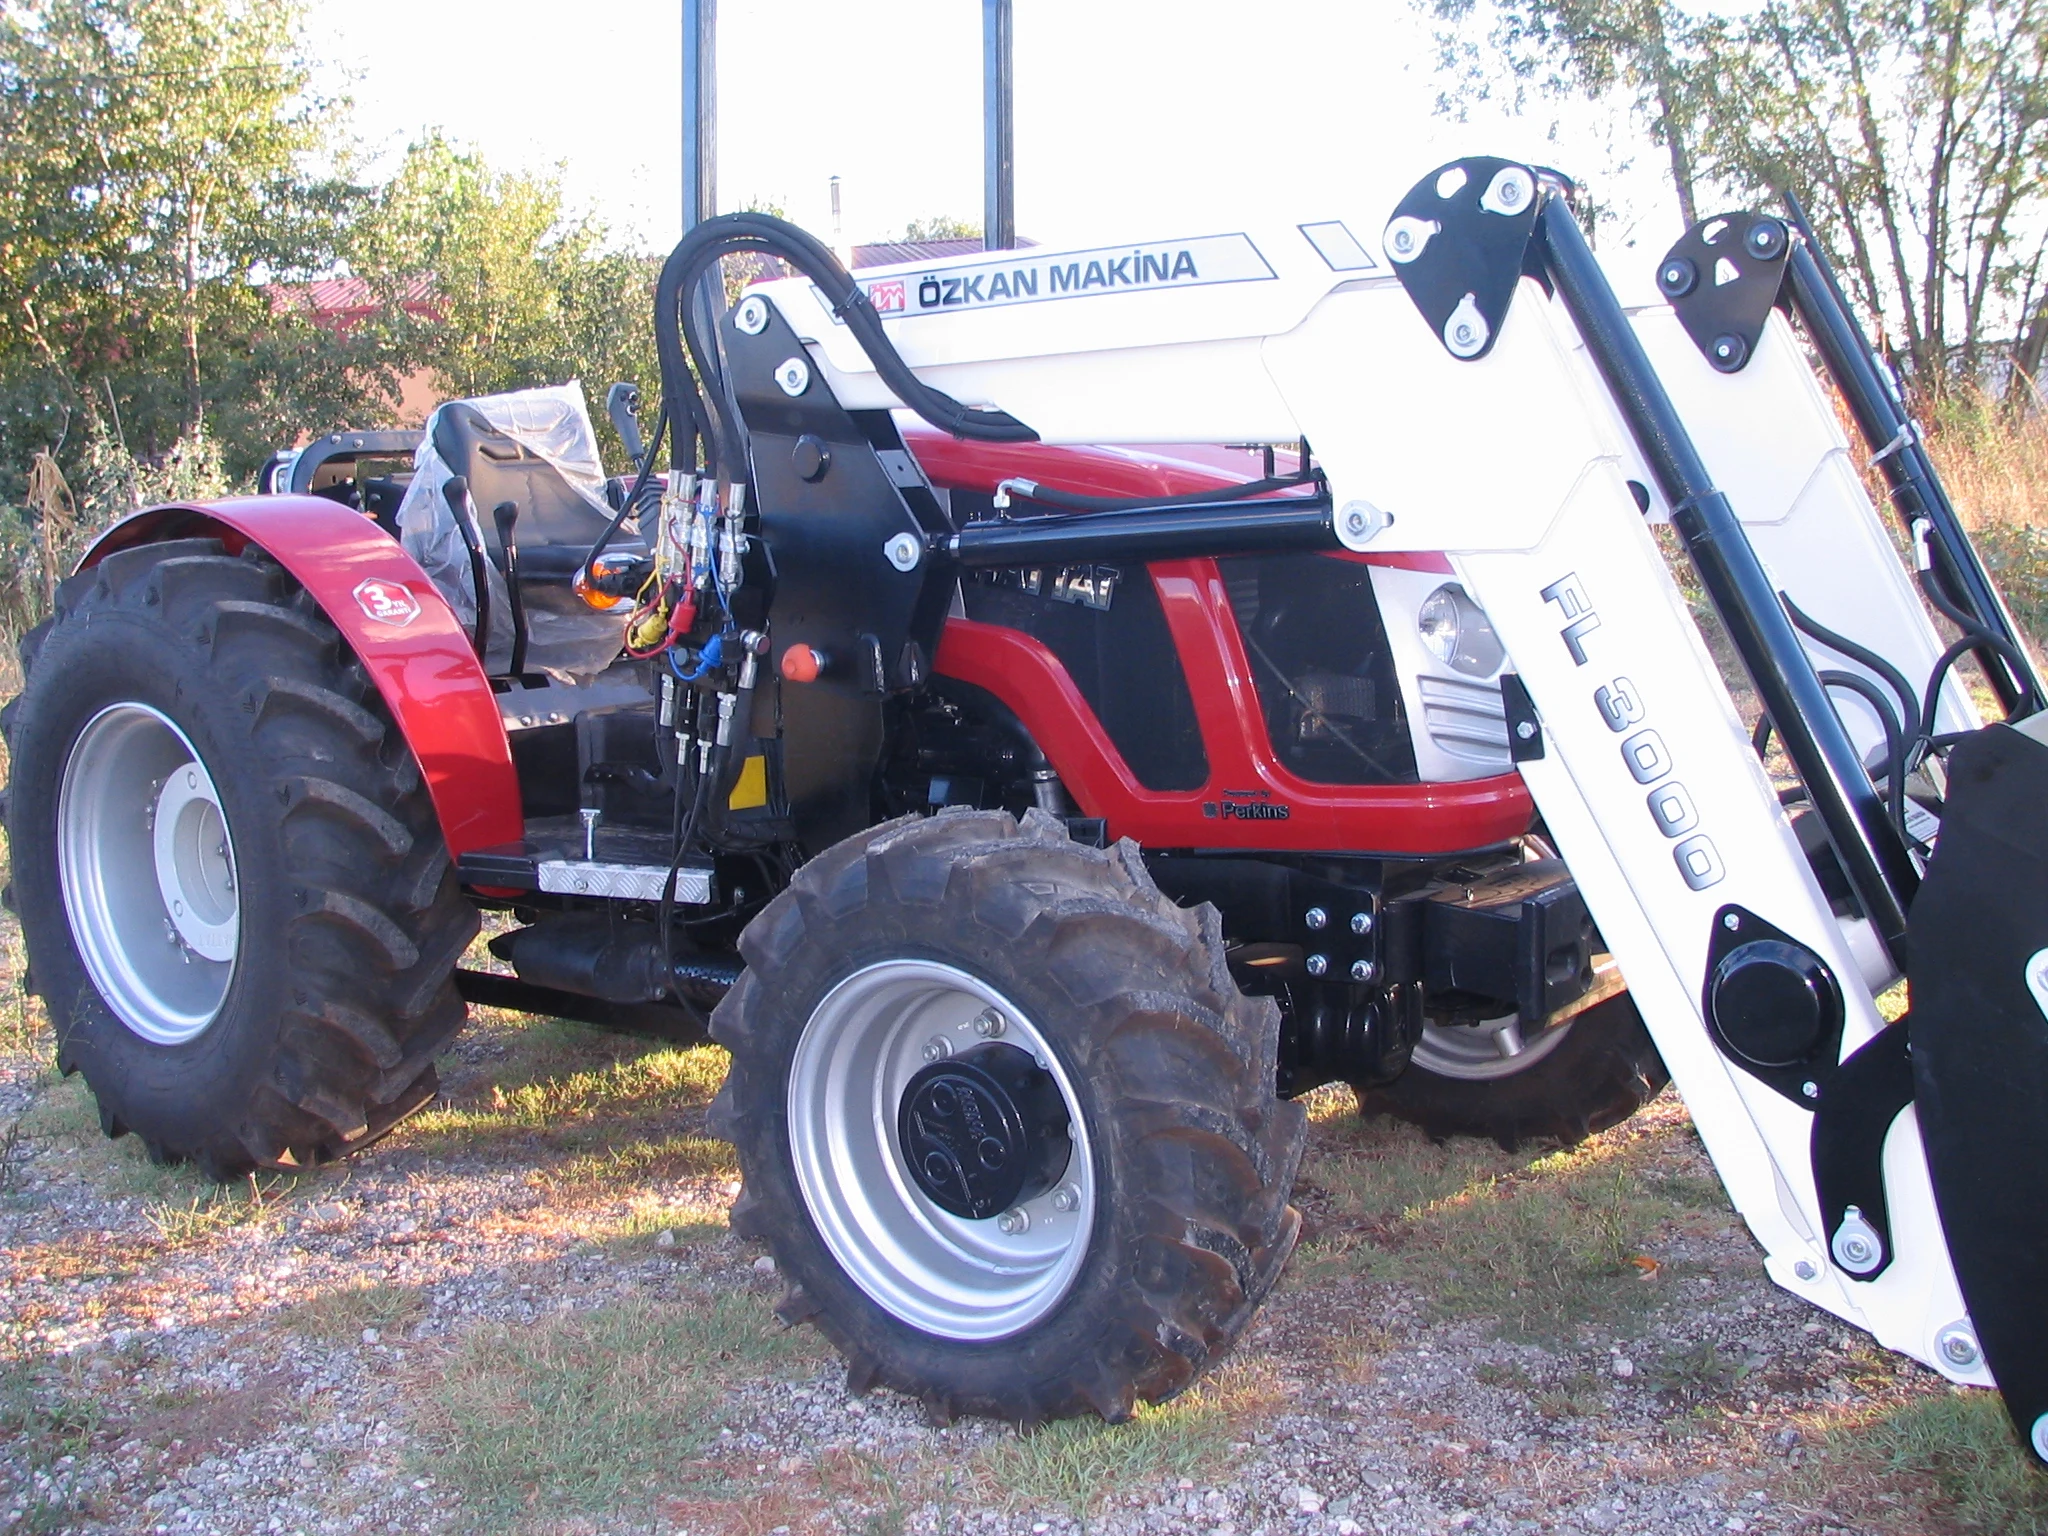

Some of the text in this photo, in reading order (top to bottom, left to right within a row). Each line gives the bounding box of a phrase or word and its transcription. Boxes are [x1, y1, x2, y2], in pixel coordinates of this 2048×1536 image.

[919, 267, 1038, 308] ÖZKAN
[1050, 250, 1199, 293] MAKİNA
[364, 585, 392, 610] 3
[1540, 571, 1727, 892] FL 3000
[1222, 801, 1290, 819] Perkins
